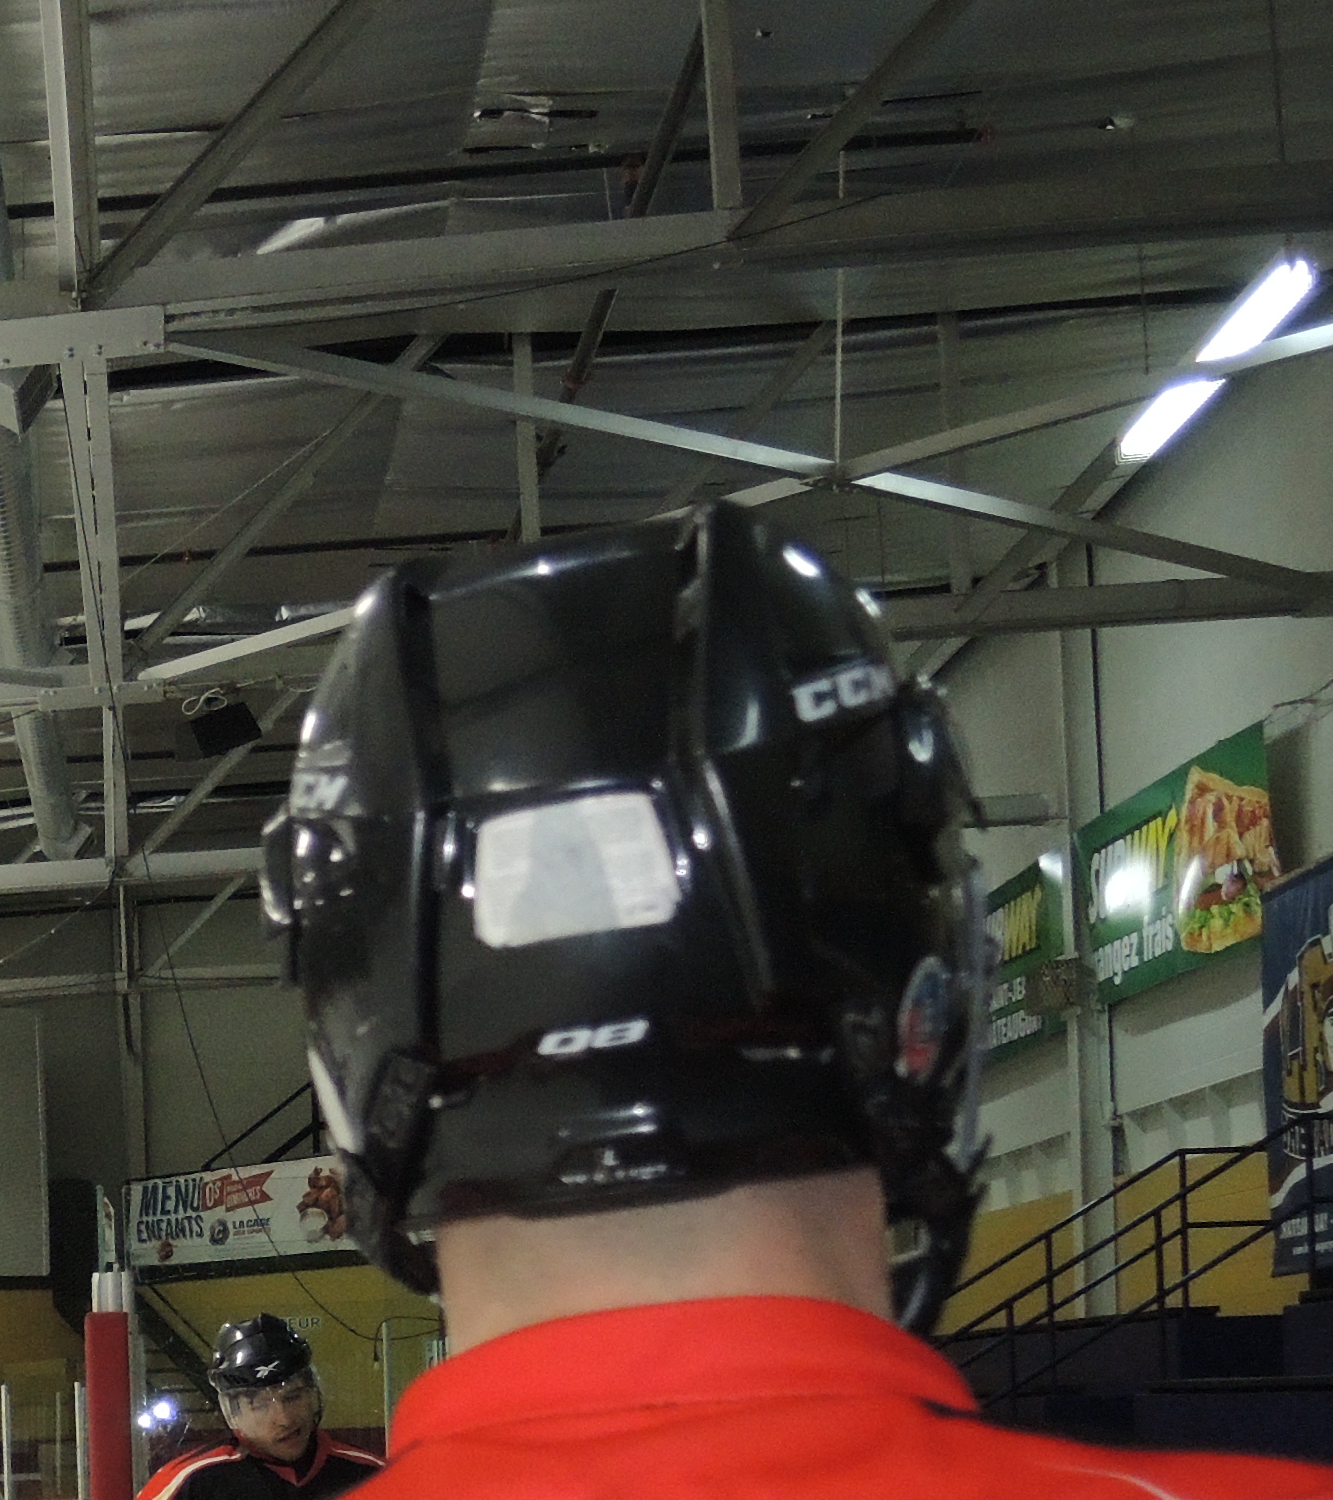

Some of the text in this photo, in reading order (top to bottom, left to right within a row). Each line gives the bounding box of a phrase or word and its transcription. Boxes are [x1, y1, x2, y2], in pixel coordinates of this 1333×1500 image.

[1095, 932, 1139, 985] angez
[139, 1177, 203, 1217] MENU
[137, 1215, 204, 1243] ENFANTS
